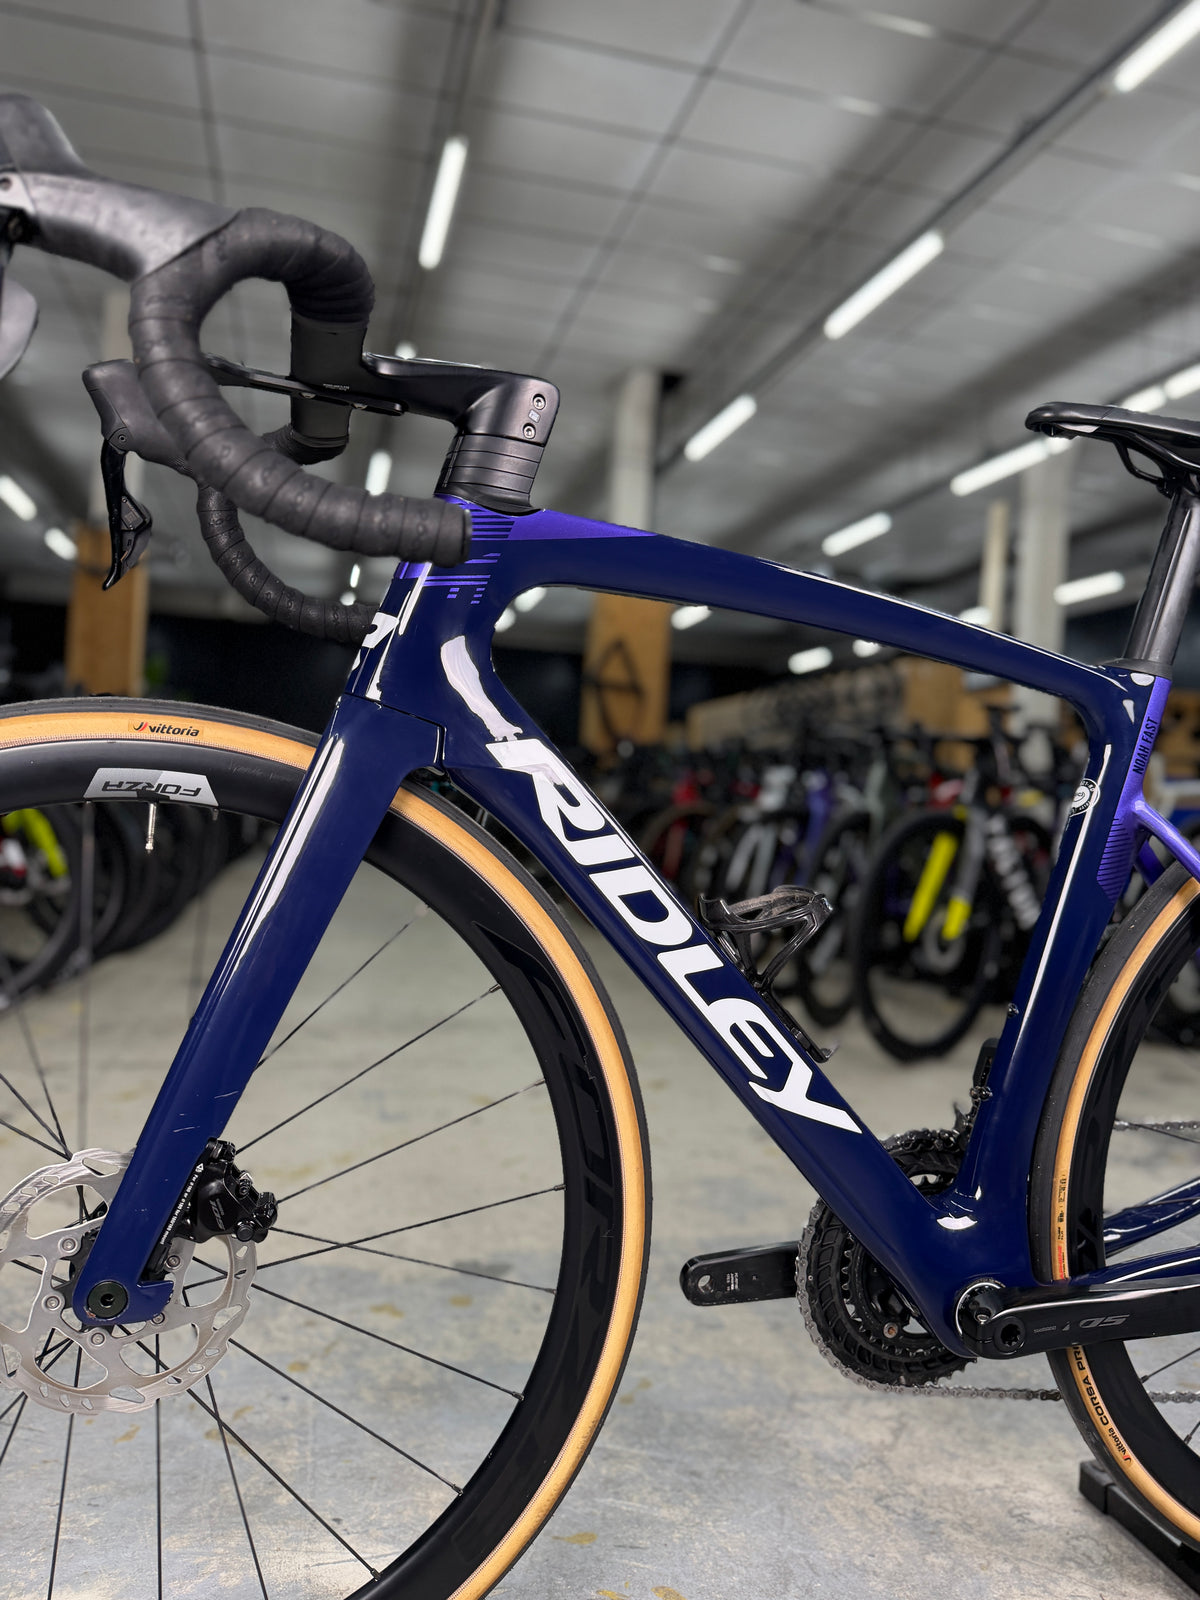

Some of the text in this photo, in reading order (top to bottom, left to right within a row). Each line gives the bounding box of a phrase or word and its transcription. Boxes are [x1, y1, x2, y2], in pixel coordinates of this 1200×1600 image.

[148, 723, 200, 737] vittoria
[1132, 716, 1159, 775] NOAH FAST
[101, 780, 202, 797] FORZA
[485, 738, 863, 1135] RIDLEY
[1082, 1374, 1110, 1426] CORSA
[1108, 1427, 1127, 1456] vittoria
